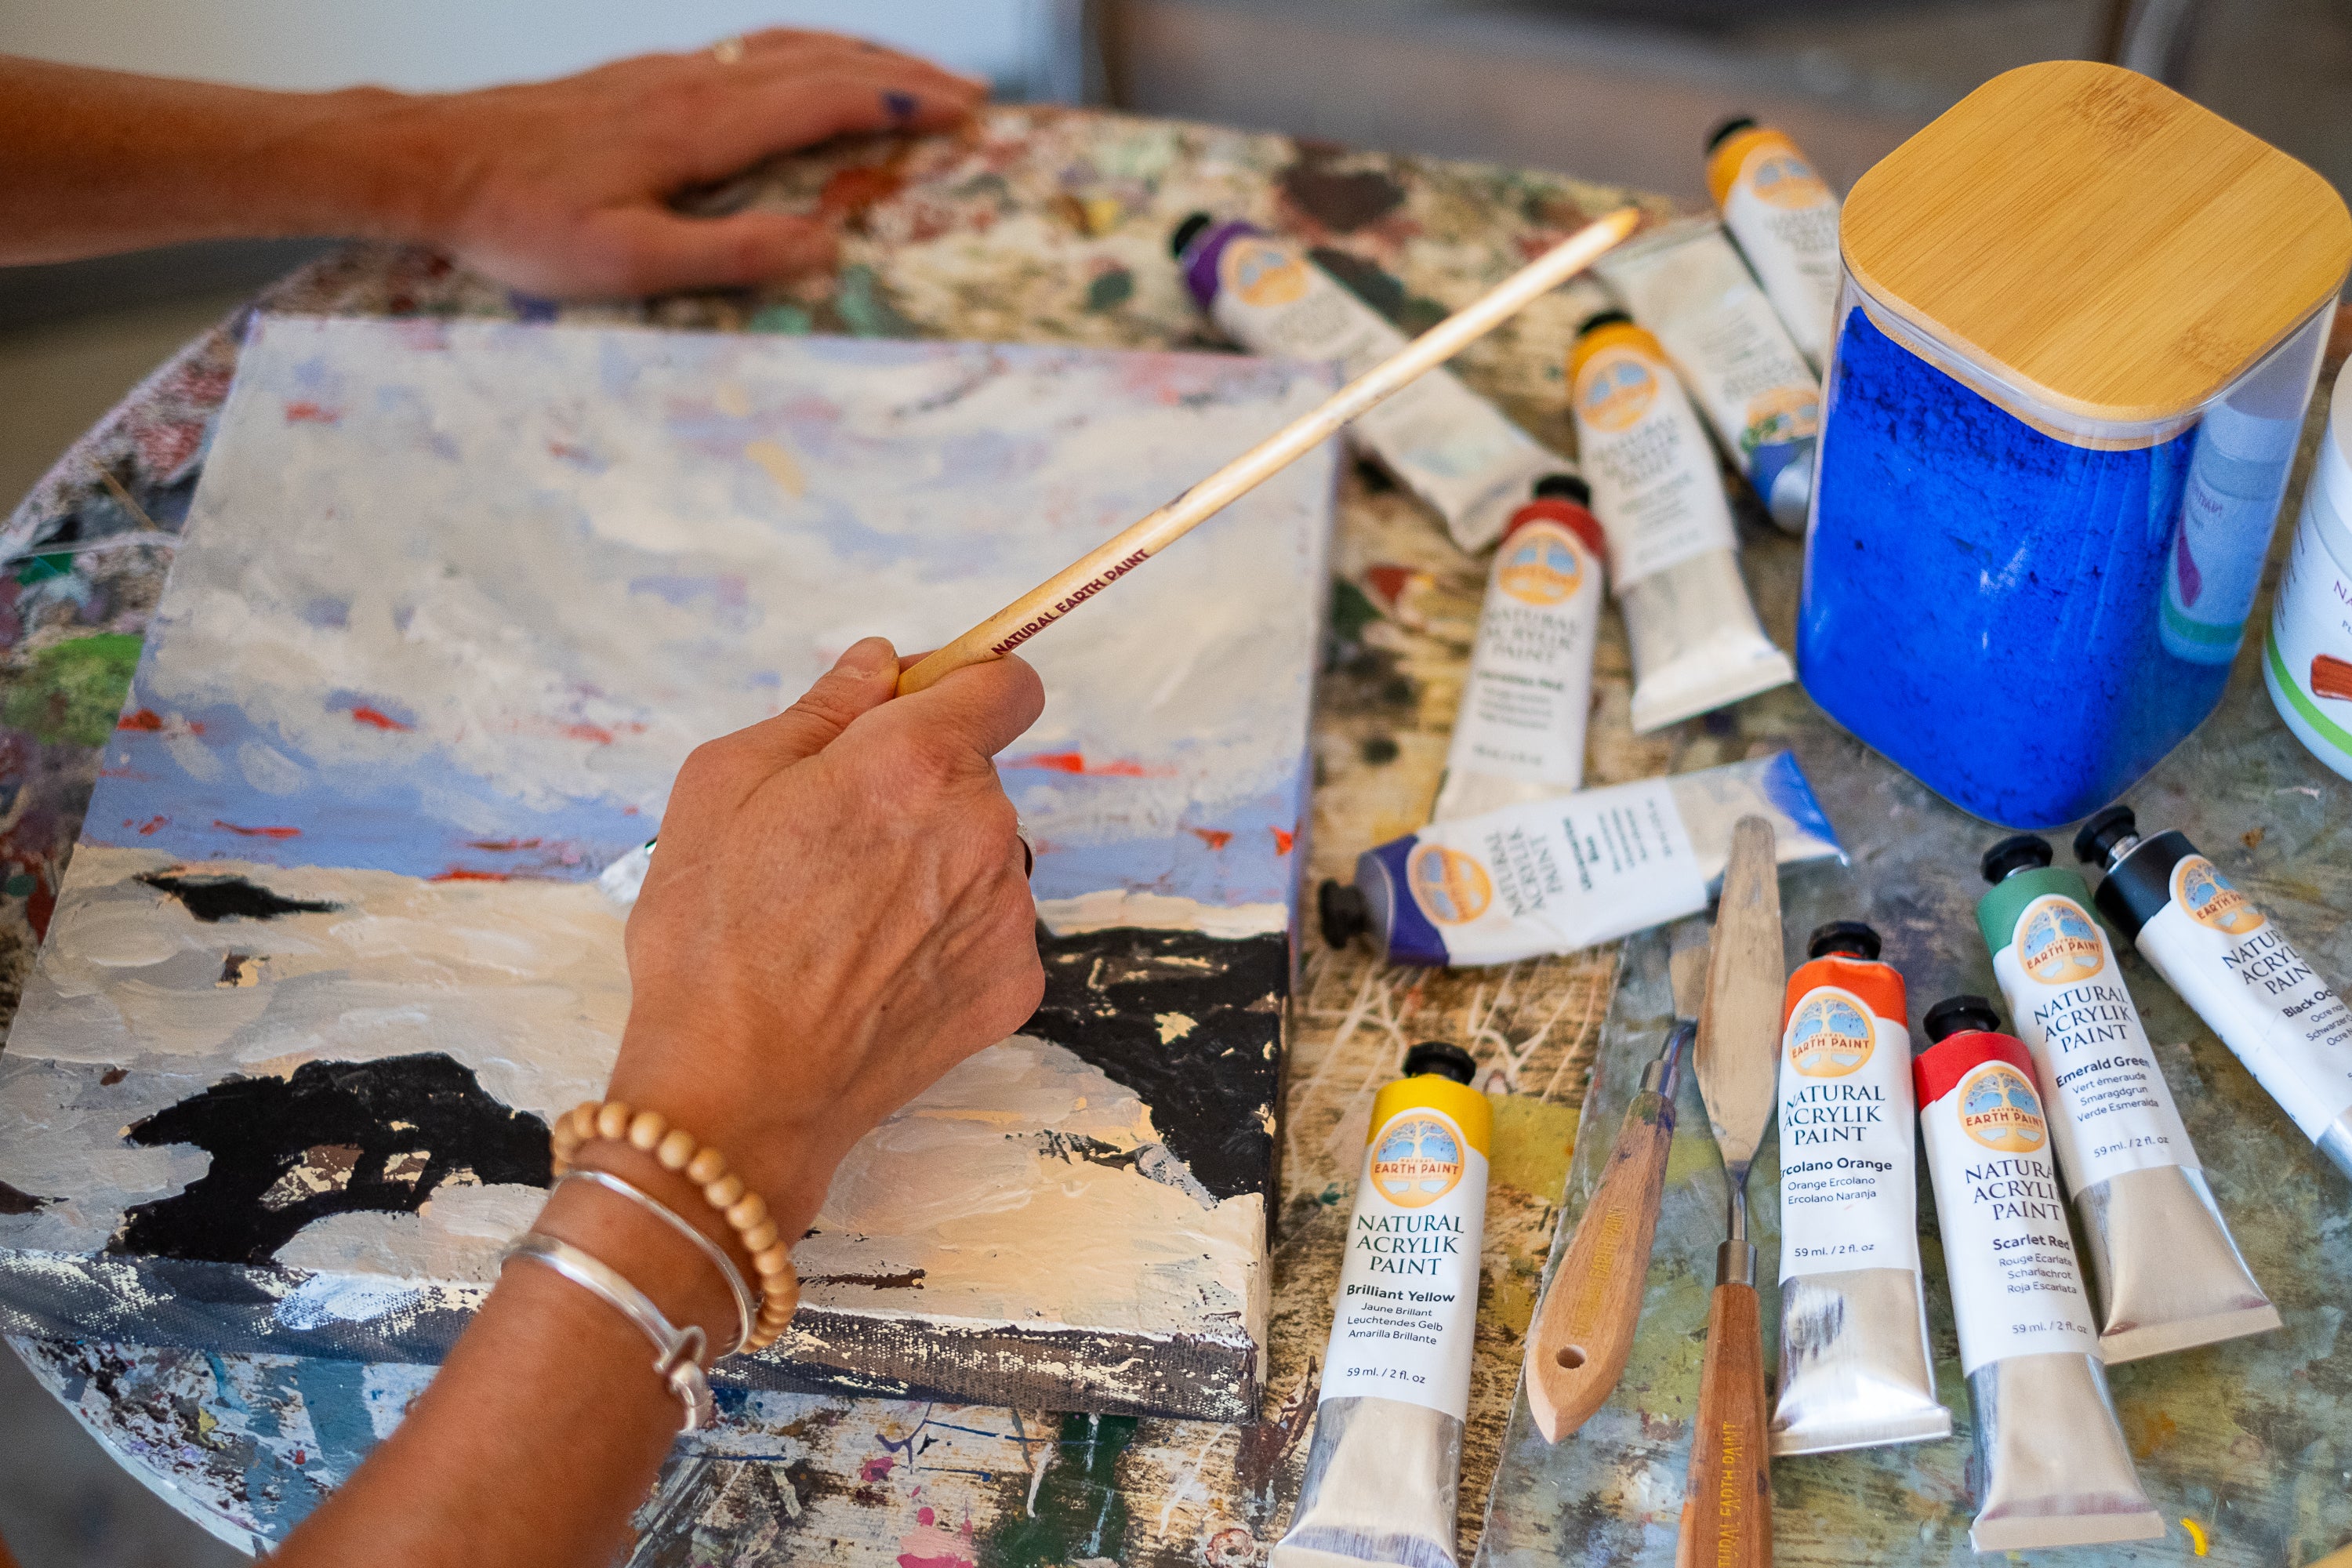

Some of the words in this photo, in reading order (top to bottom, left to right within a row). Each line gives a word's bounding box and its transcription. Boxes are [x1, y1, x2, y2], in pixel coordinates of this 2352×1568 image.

[991, 612, 1059, 655] NATURAL
[1054, 579, 1106, 613] EARTH
[1103, 548, 1151, 582] PAINT
[2197, 898, 2230, 920] EARTH
[2027, 944, 2063, 969] EARTH
[2068, 941, 2100, 952] PAINT
[2034, 985, 2128, 1025] NATURAL
[2282, 999, 2316, 1018] Black
[2045, 1005, 2133, 1043] ACRYLIK
[2310, 1009, 2332, 1022] Ocre
[2060, 1024, 2129, 1054] PAINT
[2306, 1017, 2347, 1042] Schwarzer
[2327, 1032, 2348, 1046] Ocre
[1792, 1038, 1825, 1058] EARTH
[1831, 1038, 1869, 1049] PAINT
[2056, 1058, 2111, 1088] Emerald
[2072, 1082, 2095, 1094] Vert
[2097, 1072, 2147, 1086] émeraude
[1785, 1084, 1886, 1114] NATURAL
[2080, 1085, 2148, 1106] Smaragdgrun
[1784, 1105, 1883, 1131] ACRYLIK
[2077, 1106, 2107, 1122] Verde
[2109, 1098, 2158, 1112] Esmeralda
[1966, 1112, 2009, 1127] EARTH
[2013, 1112, 2043, 1129] PAINT
[1794, 1127, 1867, 1145] PAINT
[2094, 1147, 2107, 1158] 59
[2110, 1141, 2126, 1152] ml.
[2136, 1138, 2143, 1147] 2
[2145, 1136, 2154, 1145] fl.
[1374, 1163, 1415, 1174] EARTH
[1421, 1163, 1459, 1174] PAINT
[1780, 1161, 1833, 1179] rcolano
[1837, 1157, 1893, 1172] Orange
[1788, 1180, 1827, 1191] Orange
[1829, 1176, 1875, 1188] Ercolano
[1973, 1180, 2059, 1204] ACRYLI
[1788, 1192, 1834, 1204] Ercolano
[1836, 1189, 1876, 1201] Naranja
[1992, 1201, 2060, 1221] PAINT
[1356, 1214, 1465, 1233] NATURAL
[1356, 1235, 1459, 1254] ACRYLIK
[1795, 1248, 1809, 1257] 59
[1811, 1246, 1828, 1256] ml.
[1831, 1246, 1835, 1254] /
[1839, 1245, 1845, 1254] 2
[1849, 1244, 1858, 1253] fl.
[1993, 1233, 2045, 1250] Scarlet
[2048, 1235, 2070, 1250] Red
[1369, 1256, 1442, 1275] PAINT
[1999, 1254, 2033, 1267] Rouge
[2007, 1269, 2072, 1279] Scharlachrot
[1347, 1284, 1403, 1300] Brilliant
[1408, 1291, 1455, 1302] Yellow
[2007, 1284, 2031, 1294] Roja
[2033, 1282, 2077, 1294] Escarlata
[1361, 1302, 1393, 1313] Jaune
[1396, 1307, 1432, 1316] Brillant
[1348, 1316, 1416, 1327] Leuchtendes
[1418, 1320, 1443, 1331] Gelb
[2012, 1324, 2026, 1334] 59
[2029, 1322, 2046, 1332] ml.
[2056, 1321, 2063, 1330] 2
[2065, 1321, 2075, 1331] fl.
[1348, 1330, 1390, 1338] Amarilla
[1392, 1331, 1437, 1345] Brillante
[1347, 1367, 1360, 1377] 59
[1363, 1367, 1378, 1376] ml.
[1381, 1368, 1388, 1377] /
[1390, 1370, 1396, 1378] 2
[1399, 1370, 1410, 1381] fl.
[1412, 1374, 1426, 1384] oz
